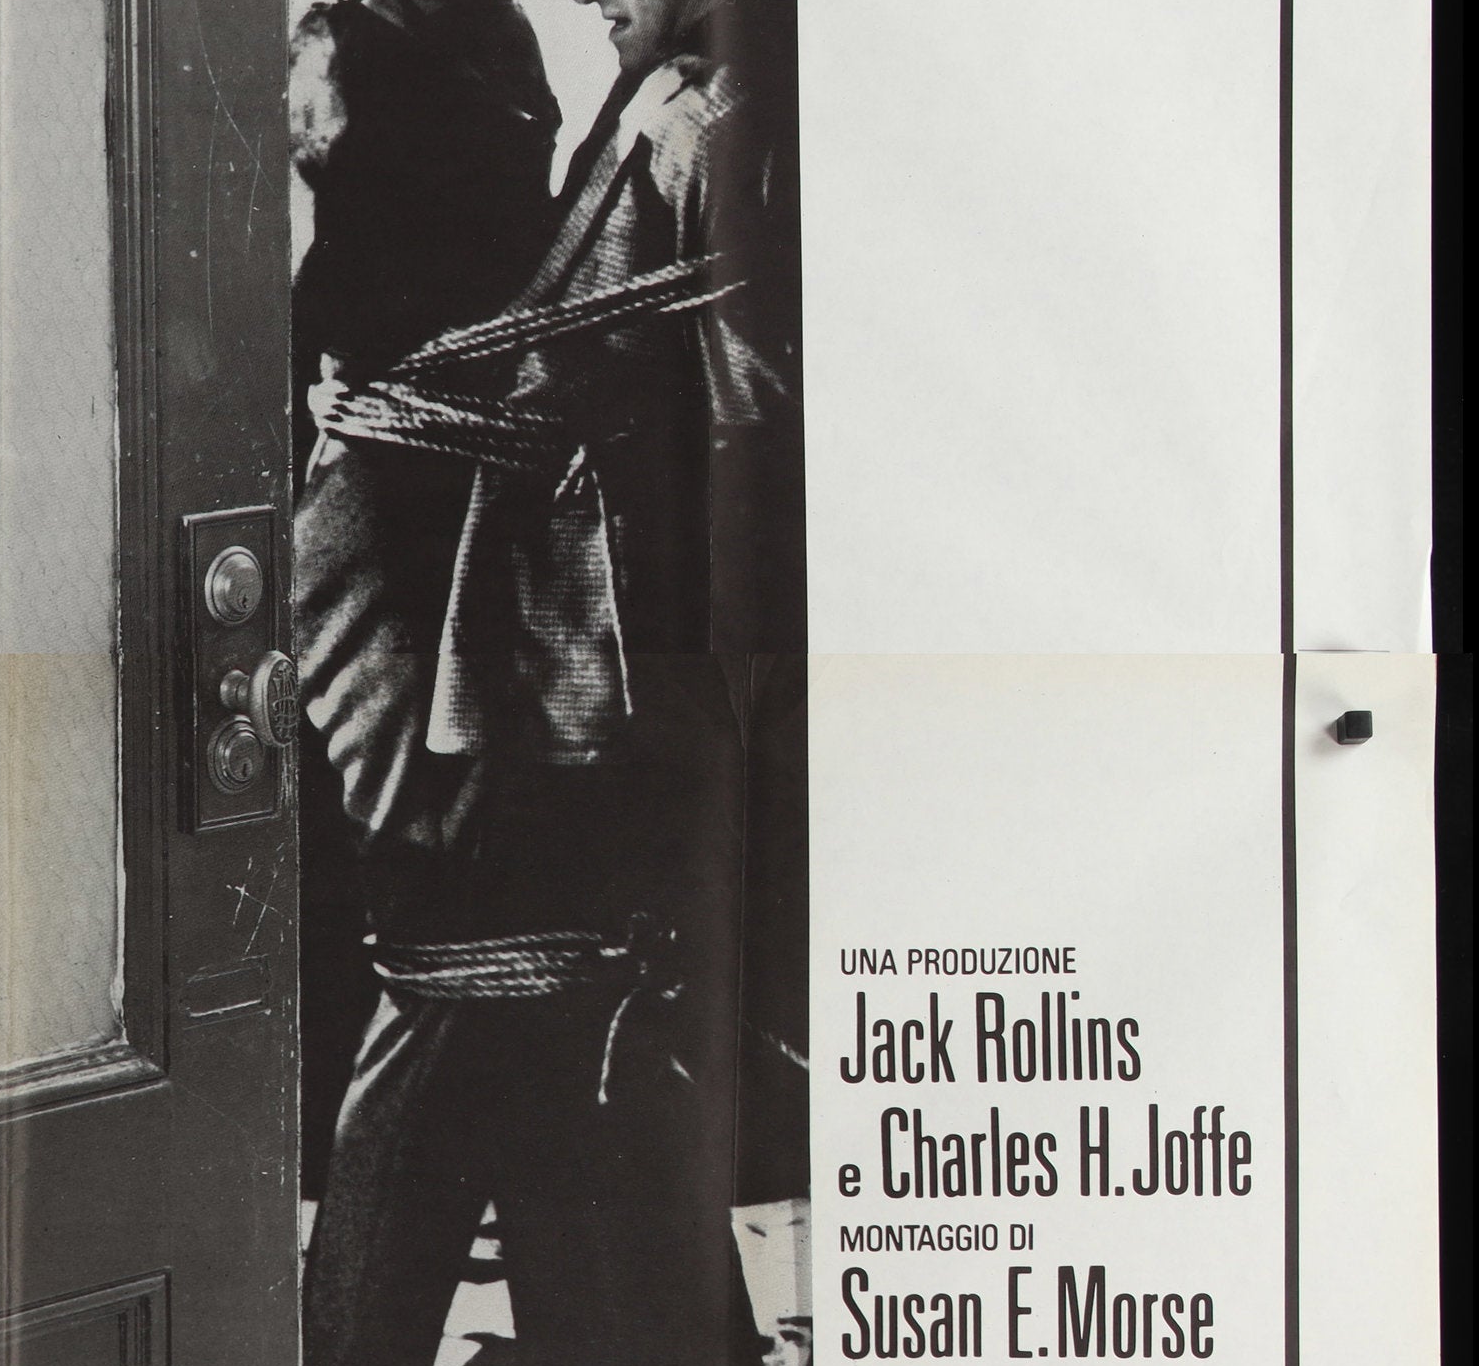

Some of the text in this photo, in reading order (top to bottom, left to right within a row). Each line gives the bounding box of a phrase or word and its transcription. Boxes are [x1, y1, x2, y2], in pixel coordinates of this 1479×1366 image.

[841, 947, 1076, 975] UNA PRODUZIONE
[840, 991, 1141, 1084] Jack Rollins
[839, 1164, 861, 1197] e
[881, 1107, 1058, 1198] Charles
[841, 1224, 1033, 1252] MONTAGGIO DI
[842, 1267, 982, 1360] Susan
